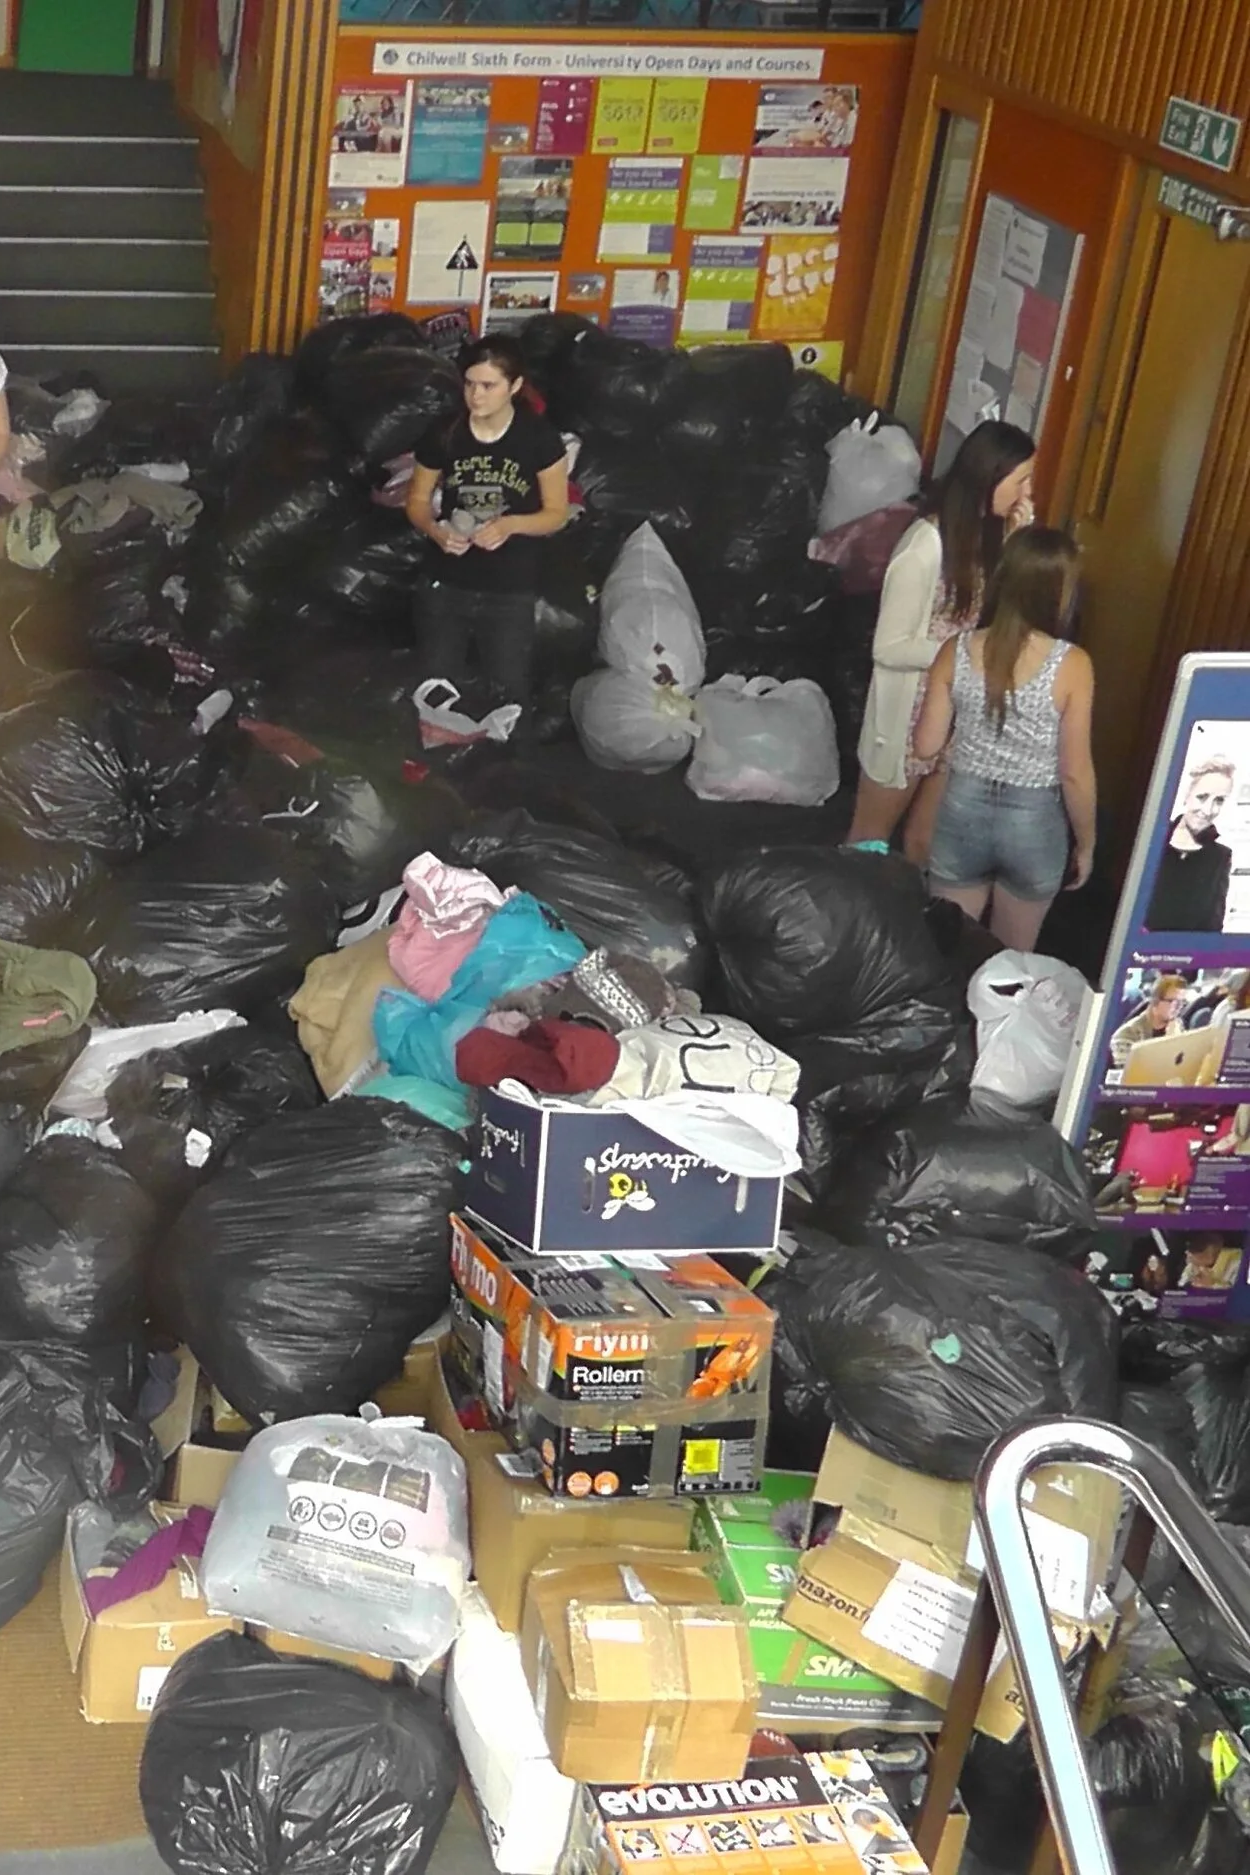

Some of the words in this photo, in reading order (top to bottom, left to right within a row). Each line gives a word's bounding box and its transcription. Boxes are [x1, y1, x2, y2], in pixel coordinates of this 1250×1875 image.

[406, 50, 467, 66] Chilwell
[472, 52, 508, 67] Sixth
[513, 53, 552, 68] Form
[565, 54, 641, 71] University
[644, 54, 685, 72] Open
[687, 55, 721, 72] Days
[726, 55, 752, 71] and
[453, 455, 493, 472] COME
[503, 457, 520, 472] TO
[597, 1142, 732, 1184] fuitways
